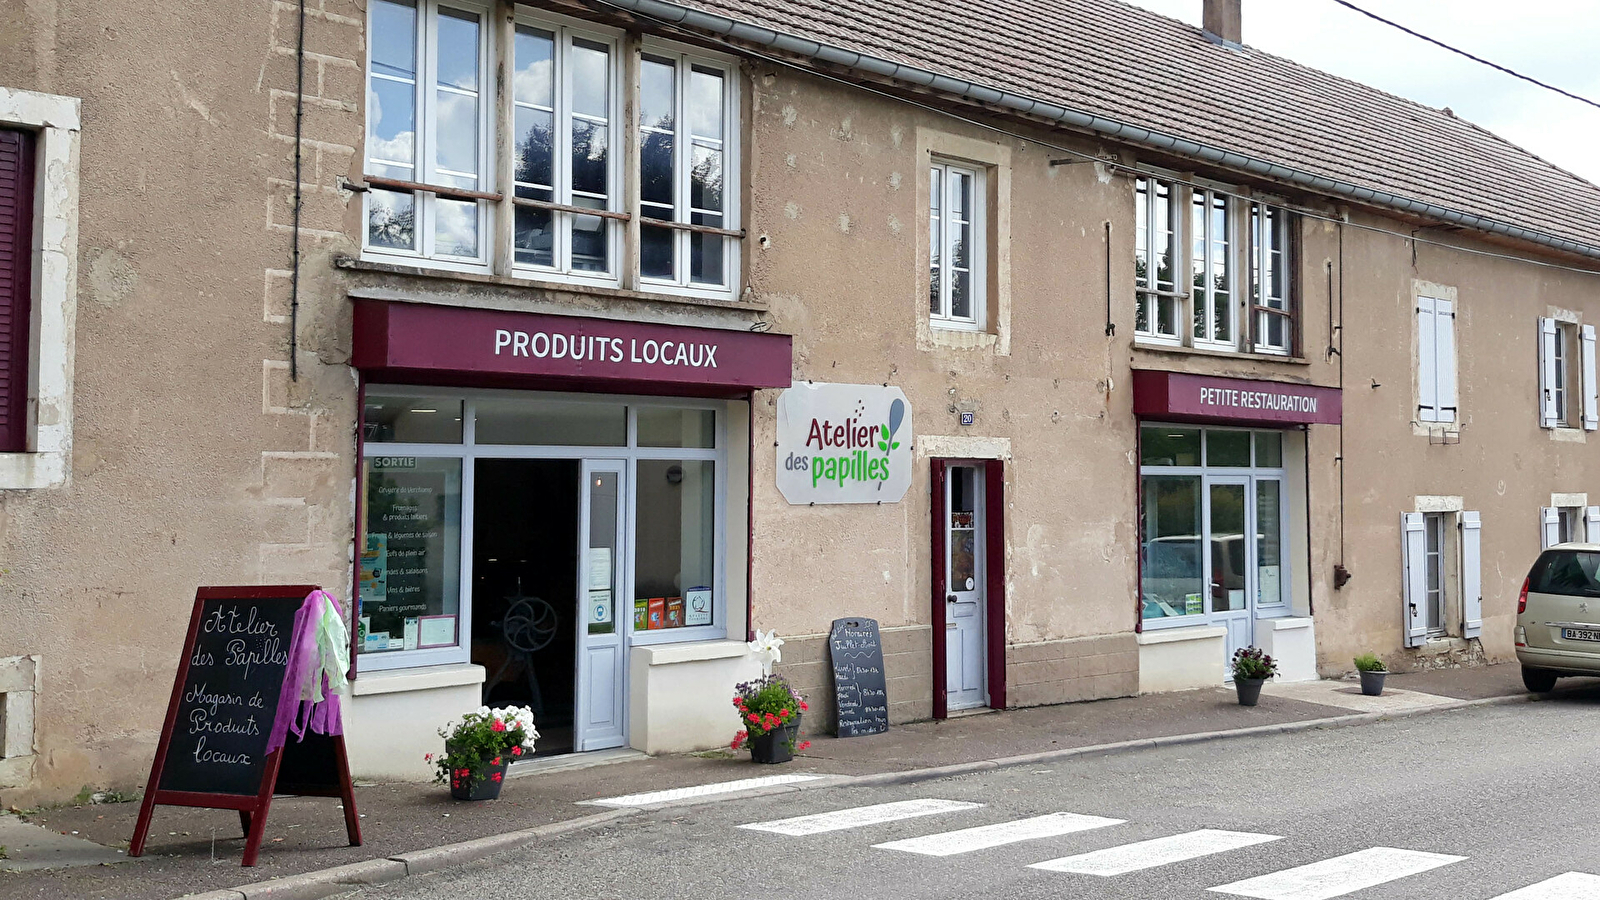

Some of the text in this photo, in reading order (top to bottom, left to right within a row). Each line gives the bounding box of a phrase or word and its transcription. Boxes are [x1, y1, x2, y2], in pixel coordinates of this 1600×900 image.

[494, 328, 718, 369] PRODUITS LOCAUX
[1200, 387, 1317, 413] PETITE RESTAURATION
[963, 413, 972, 424] 20
[806, 418, 880, 450] Atelier
[375, 457, 415, 467] SORTIE
[785, 450, 890, 488] des papilles
[405, 549, 418, 557] plein
[399, 567, 405, 575] &
[398, 585, 404, 594] &
[204, 604, 278, 636] Atelier
[378, 602, 427, 612] Paniers gourmands
[191, 637, 289, 680] des Papilles
[185, 683, 264, 717] Magasin de
[189, 708, 260, 736] Produits
